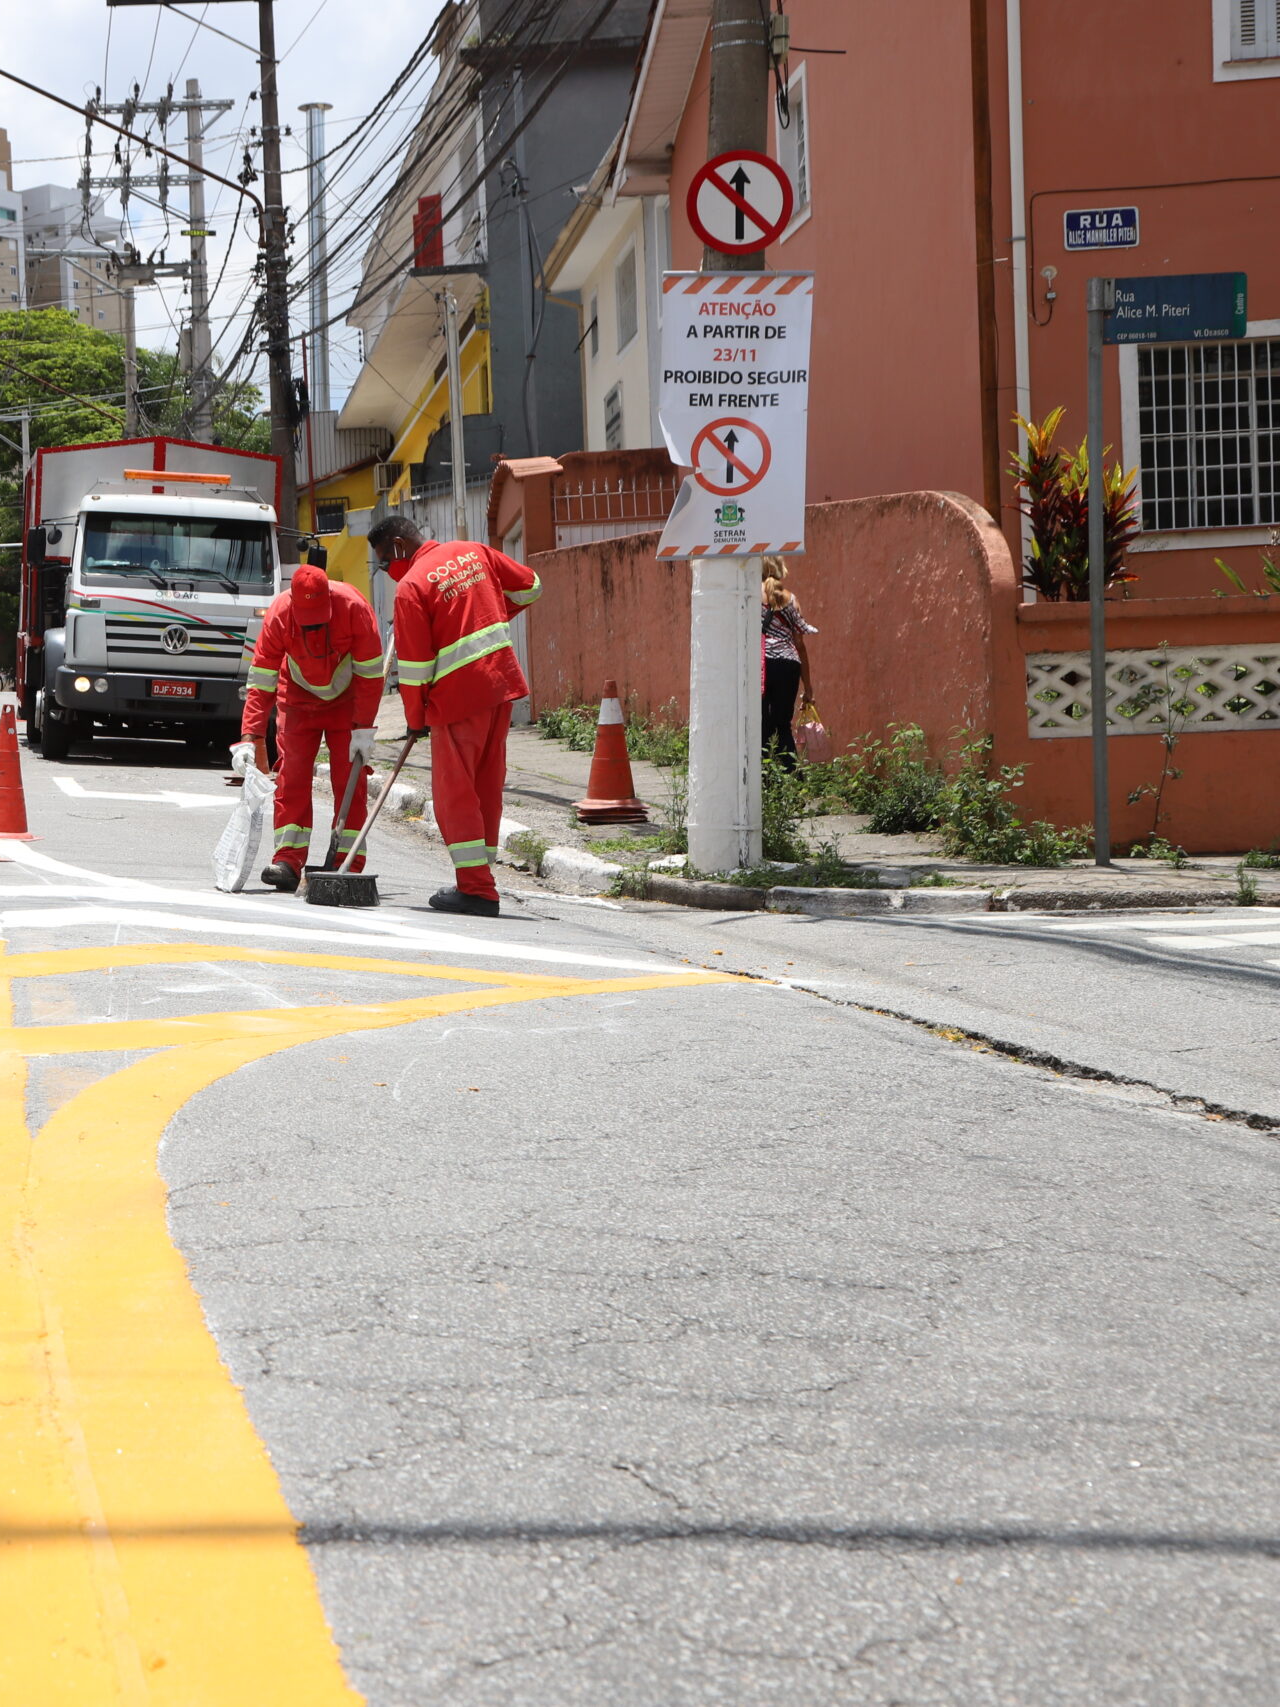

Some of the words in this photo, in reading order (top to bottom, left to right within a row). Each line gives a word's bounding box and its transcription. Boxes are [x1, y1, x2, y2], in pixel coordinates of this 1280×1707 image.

[1080, 213, 1123, 228] RUA
[1068, 230, 1085, 245] ALICE
[1115, 290, 1135, 302] Rua
[699, 299, 776, 320] ATENÇÃO
[1116, 305, 1143, 319] Alice
[1145, 304, 1158, 318] M.
[1162, 304, 1190, 317] Piteri
[686, 325, 698, 338] A
[703, 325, 760, 339] PARTIR
[765, 326, 786, 339] DE
[713, 348, 757, 362] 23/11
[664, 370, 743, 385] PROIBIDO
[747, 370, 807, 385] SEGUIR
[689, 393, 713, 407] EM
[718, 393, 779, 407] FRENTE
[713, 530, 746, 538] SETRAN
